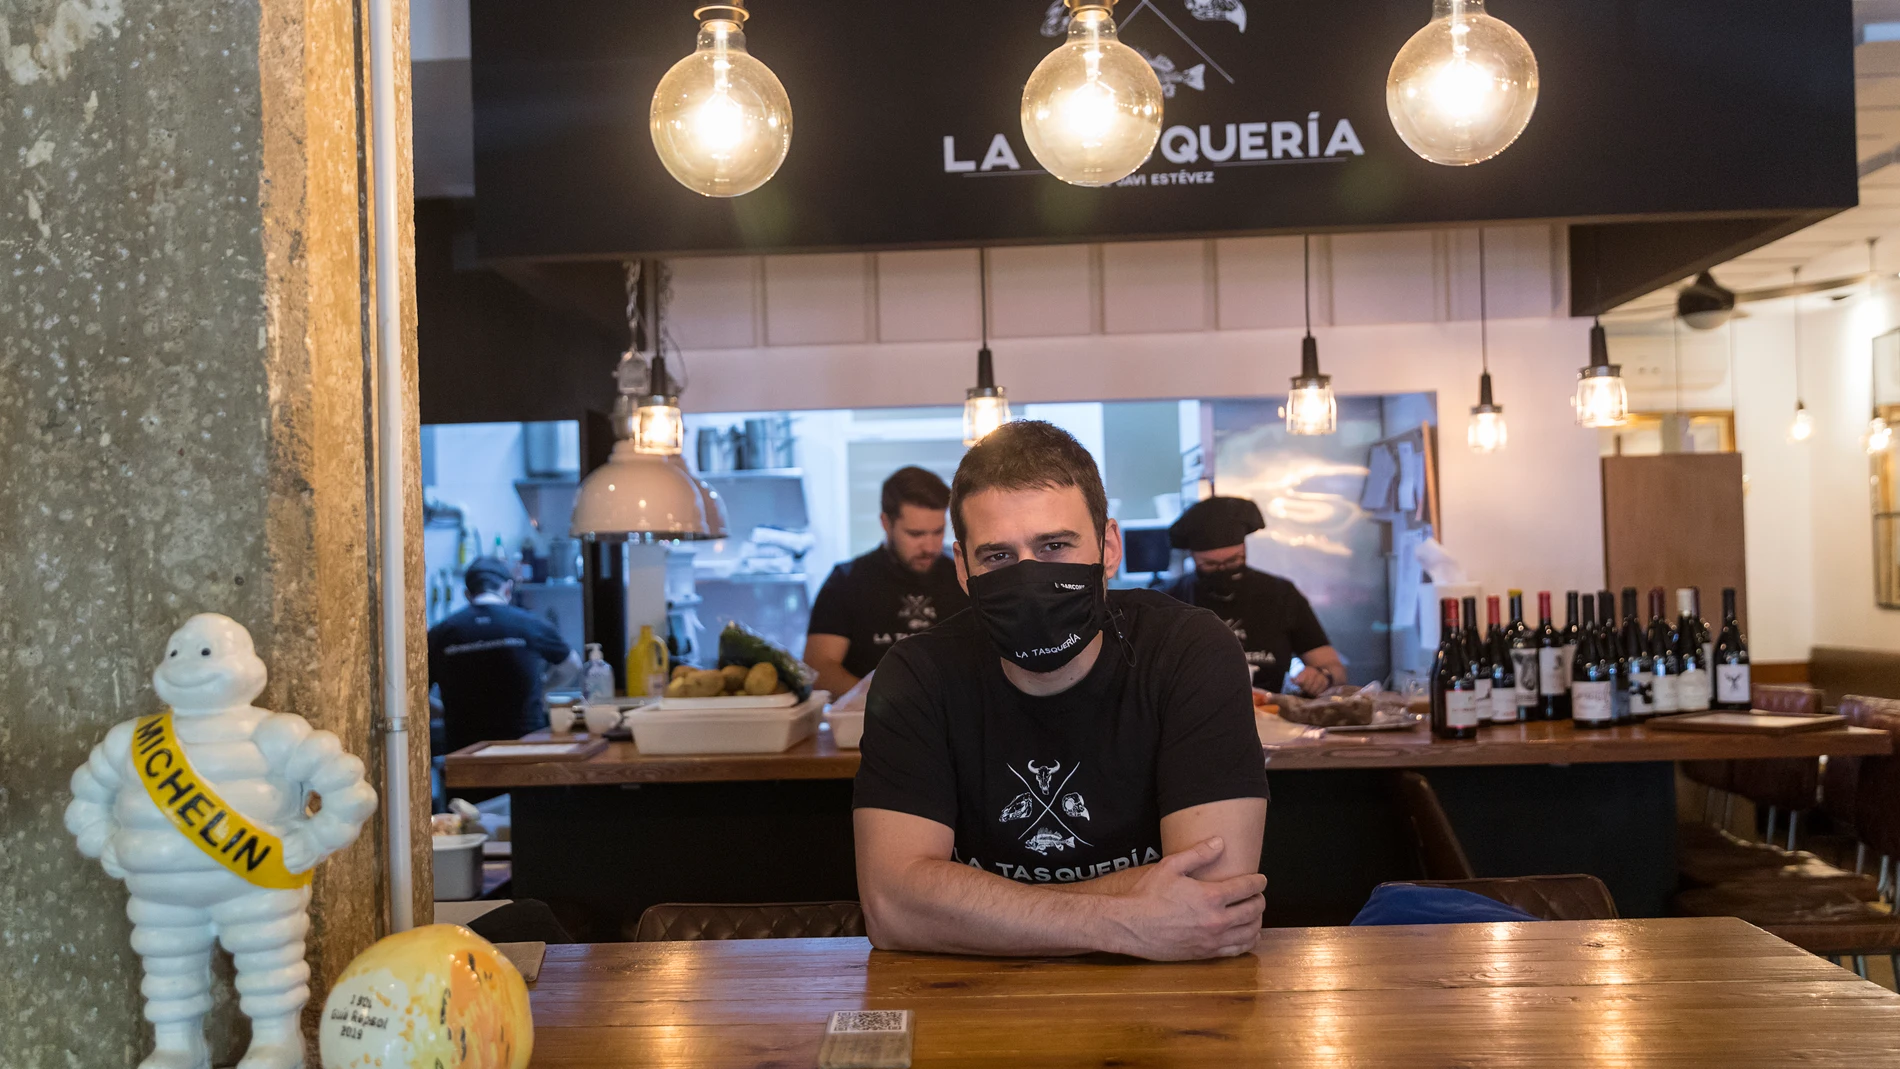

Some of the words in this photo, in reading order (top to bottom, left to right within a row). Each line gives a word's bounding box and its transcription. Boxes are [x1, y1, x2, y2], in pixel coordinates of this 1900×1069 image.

[943, 134, 1020, 172] LA
[1160, 112, 1365, 164] QUERÍA
[1150, 169, 1214, 186] ESTÉVEZ
[1015, 651, 1029, 659] LA
[1031, 632, 1081, 657] TASQUERÍA
[136, 716, 272, 872] MICHELIN
[995, 846, 1161, 882] TASQUERÍA
